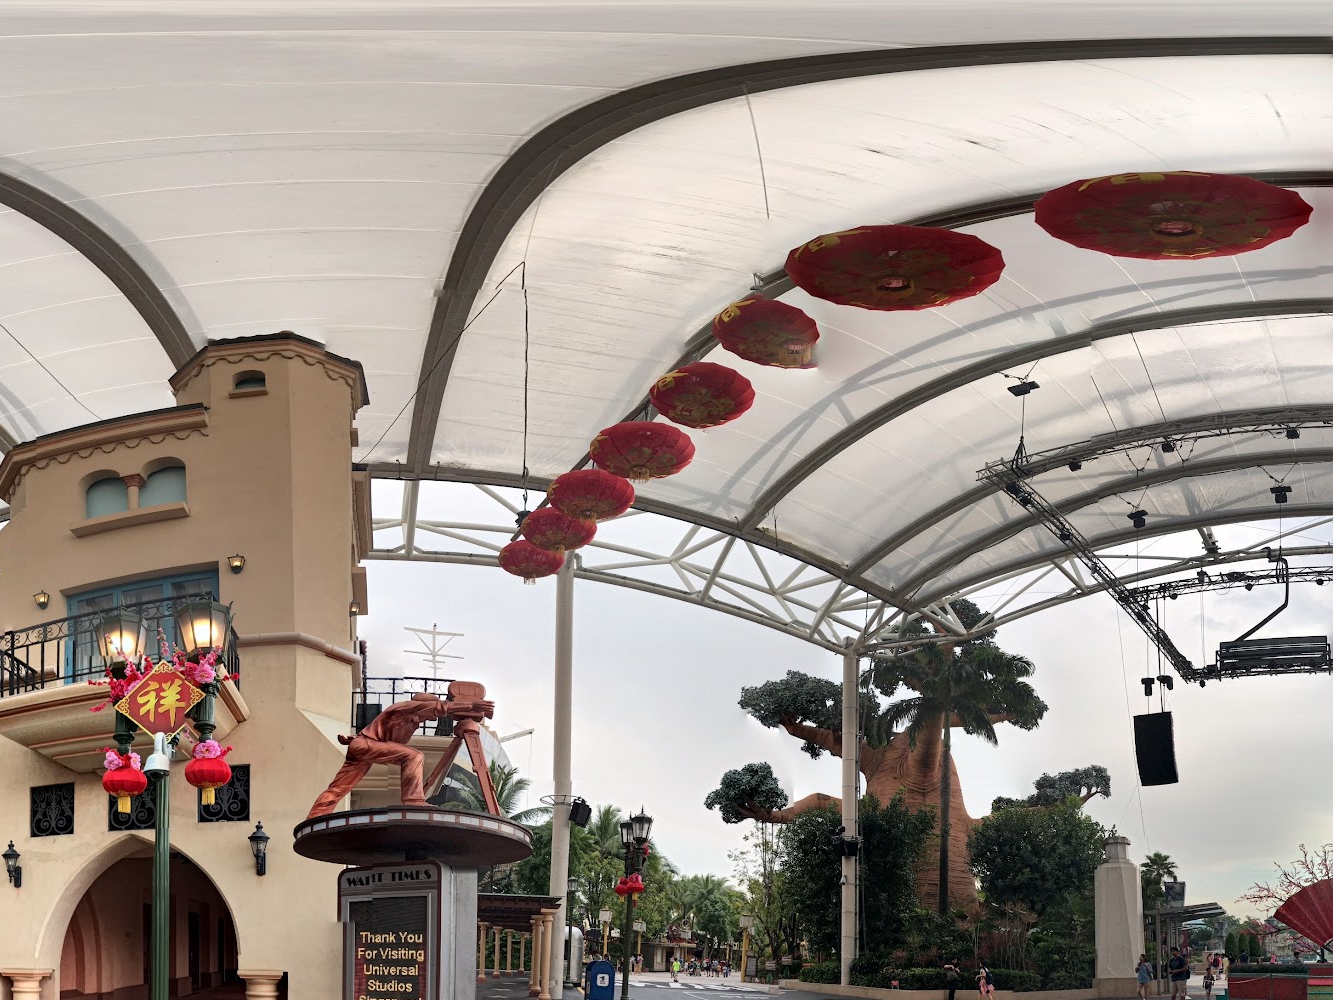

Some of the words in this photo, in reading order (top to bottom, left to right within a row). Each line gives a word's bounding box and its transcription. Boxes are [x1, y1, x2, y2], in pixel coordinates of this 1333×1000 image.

[136, 678, 185, 728] 祥
[390, 869, 433, 882] TIMES
[359, 932, 396, 944] Thank
[399, 932, 423, 943] You
[357, 947, 378, 960] For
[379, 947, 425, 962] Visiting
[363, 963, 419, 976] Universal
[367, 979, 413, 992] Studios
